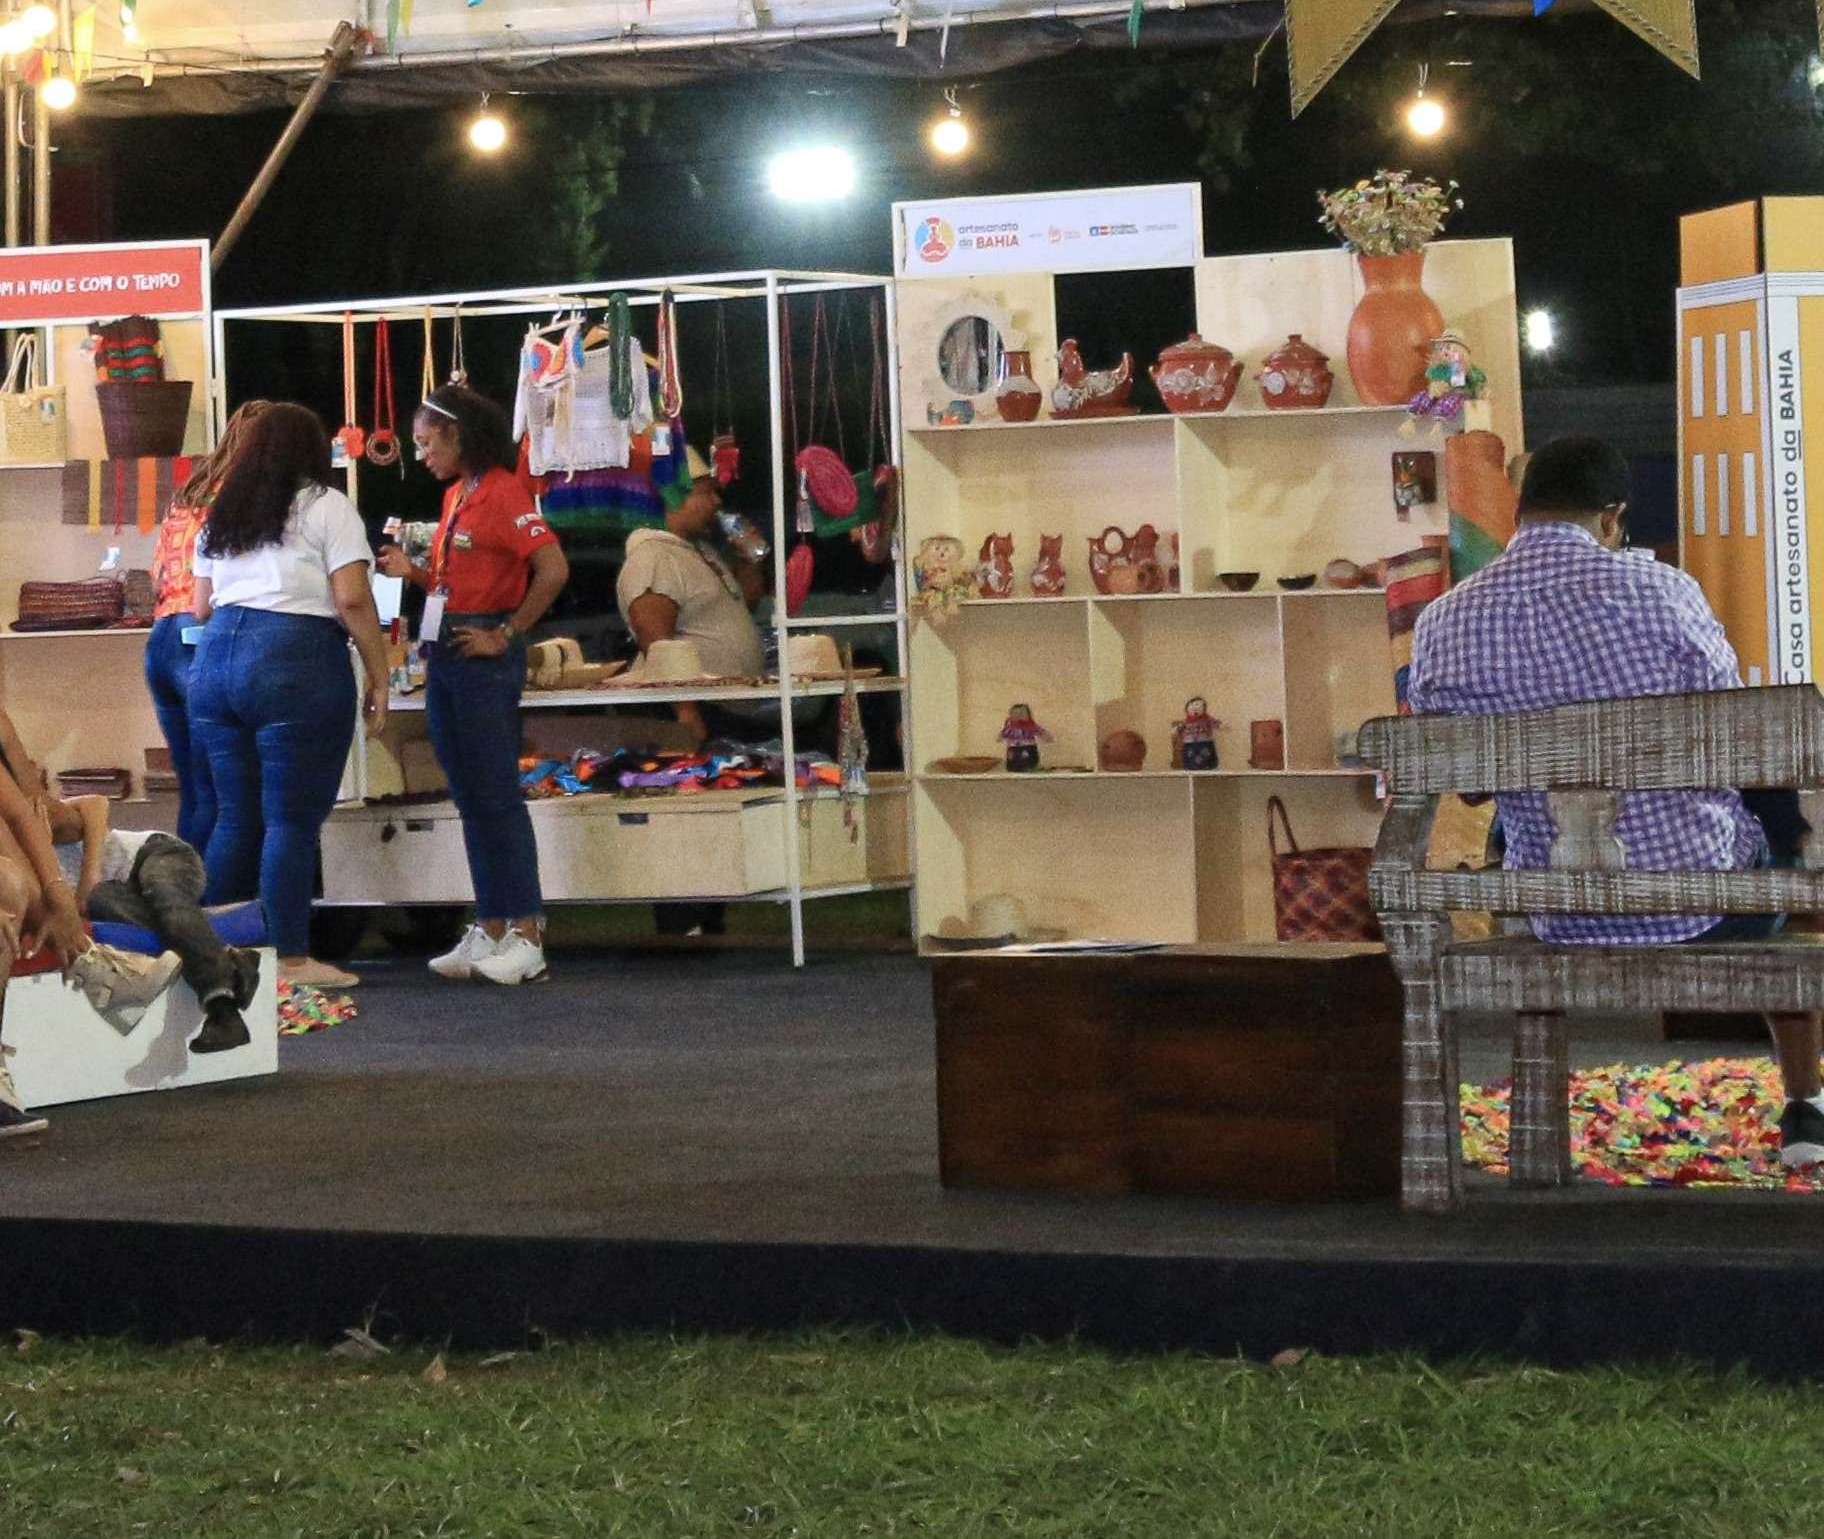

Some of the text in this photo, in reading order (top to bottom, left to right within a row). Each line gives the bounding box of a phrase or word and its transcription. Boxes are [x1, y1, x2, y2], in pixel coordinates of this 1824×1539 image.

[959, 222, 1019, 234] artesanato
[976, 235, 1019, 249] BAHIA
[16, 281, 26, 296] A
[30, 278, 62, 295] MÃO
[66, 277, 75, 293] E
[79, 275, 112, 292] COM
[116, 275, 128, 290] O
[132, 273, 180, 291] TEMPO
[1780, 348, 1804, 685] Casa artesanato da BAHIA
